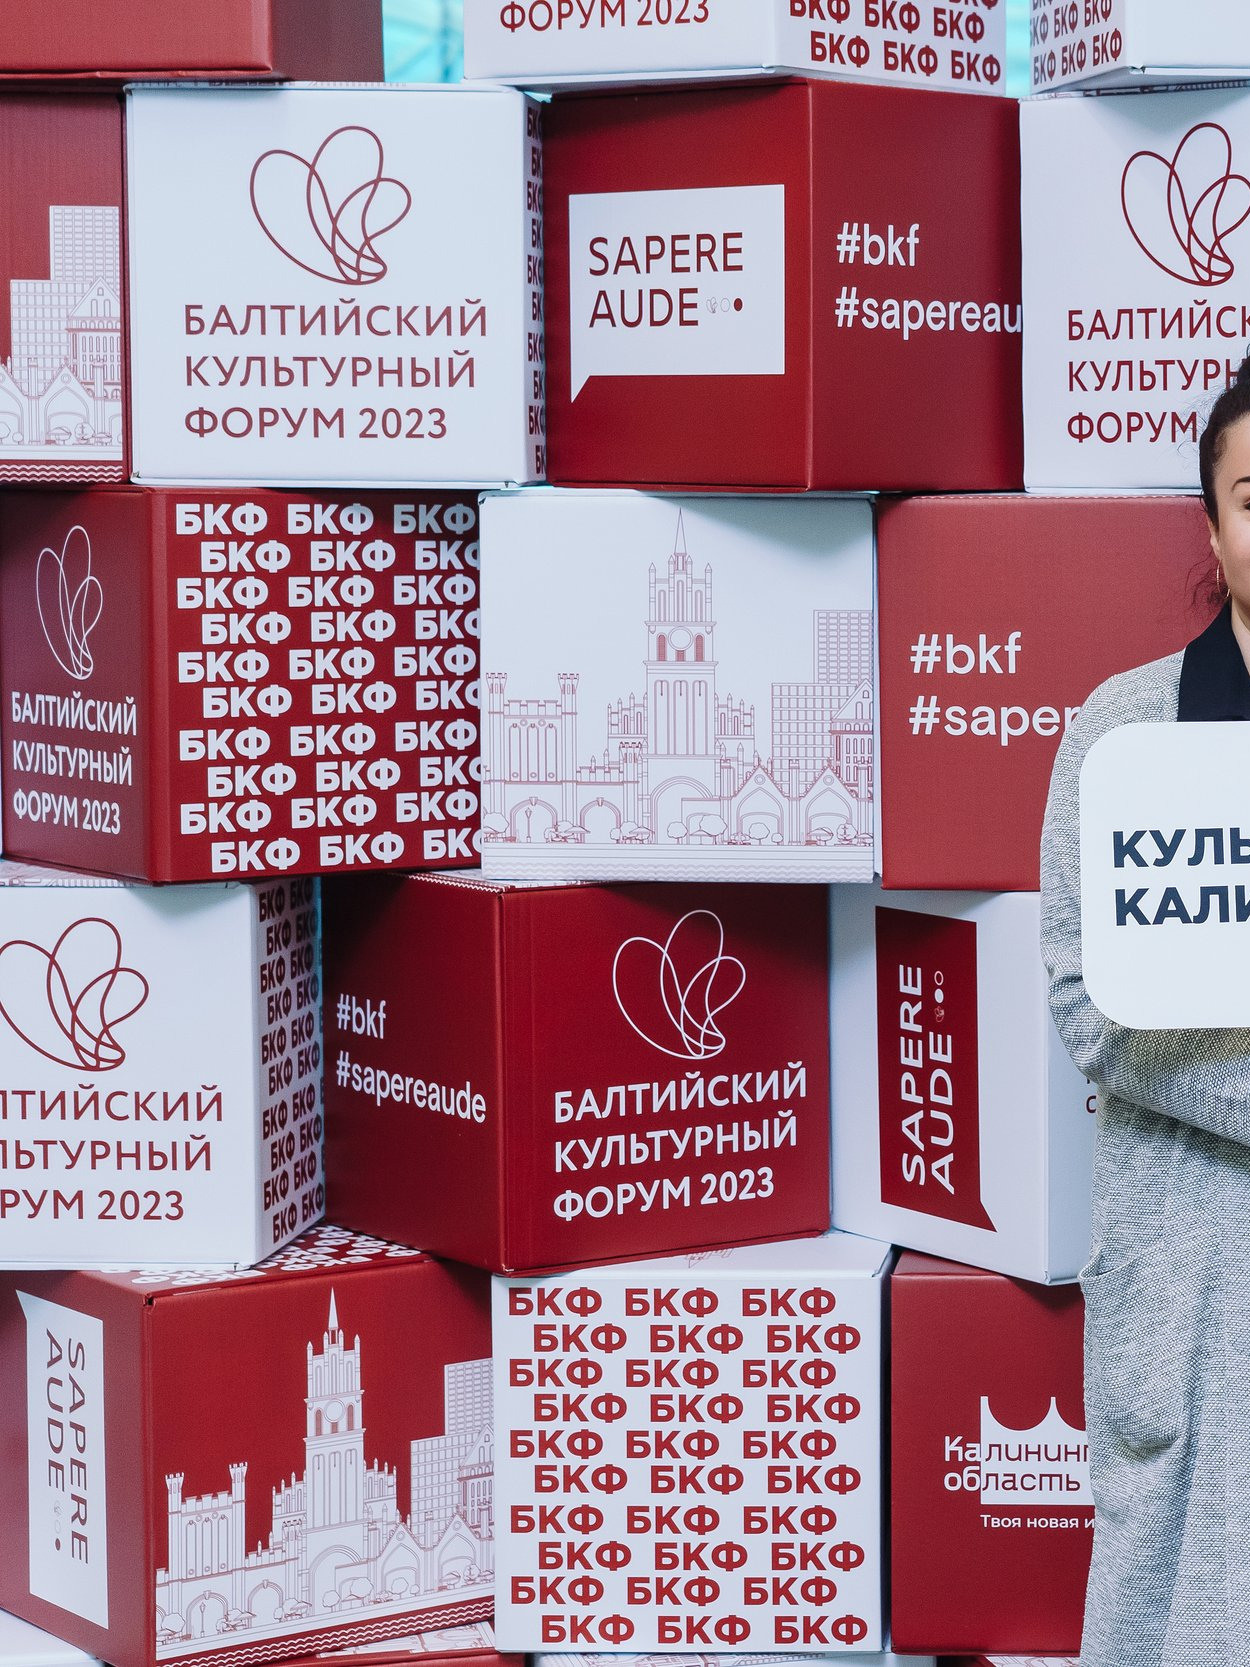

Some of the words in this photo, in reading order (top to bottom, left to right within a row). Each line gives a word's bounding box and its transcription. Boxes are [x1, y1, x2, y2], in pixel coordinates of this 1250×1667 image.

[500, 0, 625, 32] ФОРУМ
[637, 0, 708, 25] 2023
[865, 0, 920, 33] БКФ
[934, 7, 984, 43] БКФ
[1054, 1, 1079, 35] БКФ
[811, 31, 869, 68] БКФ
[884, 41, 938, 76] БКФ
[951, 50, 1001, 86] БКФ
[1033, 49, 1056, 86] БКФ
[1062, 39, 1087, 77] БКФ
[1093, 28, 1124, 66] БКФ
[590, 232, 743, 276] SAPERE
[837, 222, 919, 266] #bkf
[185, 298, 486, 336] БАЛТИЙСКИЙ
[589, 288, 698, 327] AUDE
[835, 287, 1021, 340] #sapereau
[186, 351, 475, 388] КУЛЬТУРНЫЙ
[185, 407, 344, 438] ФОРУМ
[359, 408, 446, 438] 2023
[1068, 412, 1197, 443] ФОРУМ
[175, 502, 267, 535] БКФ
[288, 504, 373, 535] БКФ
[394, 504, 477, 534] БКФ
[176, 575, 268, 609] БКФ
[288, 575, 374, 607] БКФ
[394, 575, 477, 606] БКФ
[178, 649, 269, 683] БКФ
[289, 647, 375, 679] БКФ
[395, 645, 477, 677] БКФ
[910, 632, 1021, 674] #bkf
[11, 690, 137, 736] БАЛТИЙСКИЙ
[180, 727, 270, 761] БКФ
[290, 723, 375, 756] БКФ
[395, 720, 478, 751] БКФ
[13, 739, 132, 786] КУЛЬТУРНЫЙ
[13, 788, 78, 828] ФОРУМ
[82, 798, 121, 835] 2023
[181, 800, 271, 834] БКФ
[291, 794, 376, 828] БКФ
[397, 790, 478, 822] БКФ
[212, 838, 300, 873] БКФ
[320, 831, 404, 866] БКФ
[337, 994, 386, 1039] #bkf
[337, 1051, 486, 1123] #sapereaude
[555, 1061, 806, 1123] БАЛТИЙСКИЙ
[900, 965, 925, 1185] SAPERE
[929, 1032, 954, 1194] AUDE
[555, 1110, 797, 1173] КУЛЬТУРНЫЙ
[0, 1190, 83, 1219] РУМ
[98, 1190, 183, 1220] 2023
[553, 1176, 691, 1221] ФОРУМ
[700, 1167, 775, 1205] 2023
[509, 1287, 602, 1317] БКФ
[626, 1288, 718, 1317] БКФ
[742, 1287, 836, 1317] БКФ
[534, 1323, 627, 1353] БКФ
[650, 1324, 743, 1354] БКФ
[767, 1324, 860, 1354] БКФ
[46, 1328, 65, 1492] AUDE
[534, 1393, 627, 1423] БКФ
[651, 1393, 743, 1423] БКФ
[767, 1393, 860, 1423] БКФ
[68, 1338, 88, 1564] SAPERE
[510, 1429, 603, 1459] БКФ
[627, 1430, 719, 1460] БКФ
[743, 1430, 836, 1460] БКФ
[943, 1465, 1081, 1491] область
[511, 1504, 603, 1534] БКФ
[627, 1505, 719, 1535] БКФ
[744, 1505, 837, 1535] БКФ
[980, 1514, 1022, 1528] Твоя
[1026, 1517, 1079, 1528] новая
[542, 1614, 634, 1644] БКФ
[658, 1615, 750, 1645] БКФ
[775, 1615, 868, 1646] БКФ
